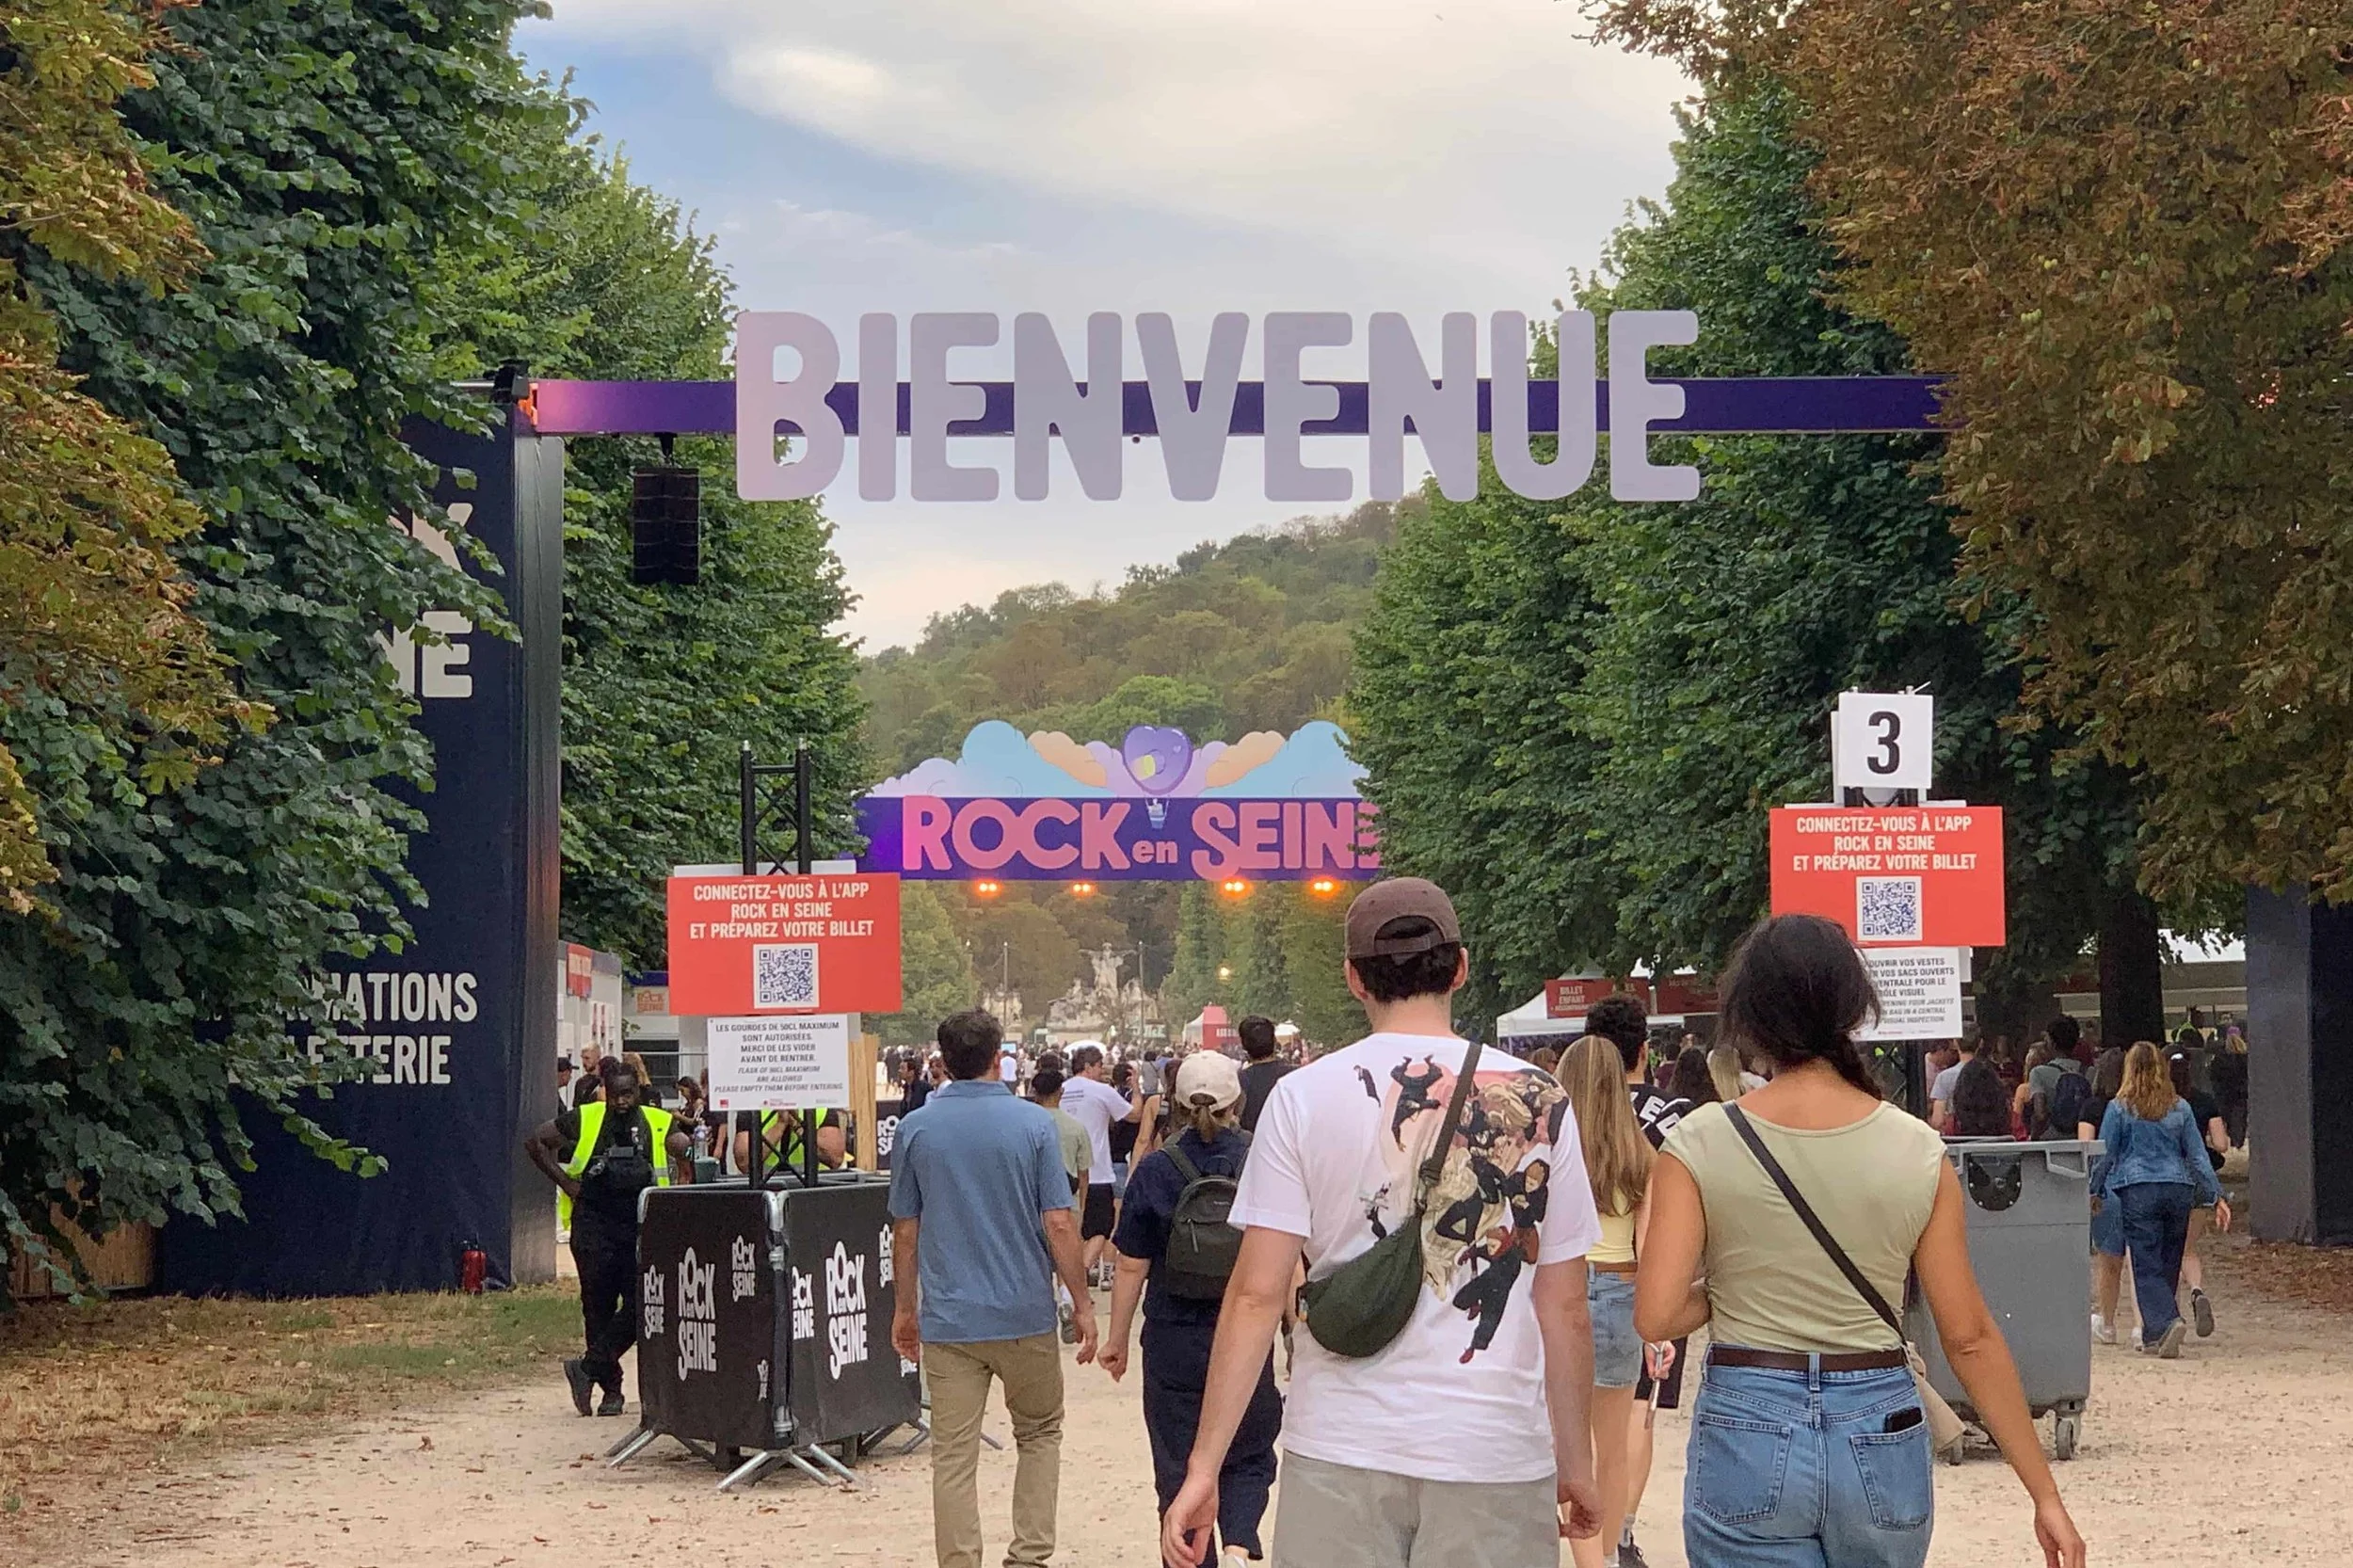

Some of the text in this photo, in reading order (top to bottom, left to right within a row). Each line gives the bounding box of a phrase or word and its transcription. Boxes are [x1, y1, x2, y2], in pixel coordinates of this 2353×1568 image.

[737, 312, 1700, 502] BIENVENUE
[1867, 711, 1901, 775] 3
[903, 795, 1381, 881] ROCK en SEINE
[1797, 811, 1973, 834] CONNECTEZ-VOUS À L'APP
[1834, 835, 1936, 852] ROCK EN SEINE
[1793, 852, 1977, 872] ET PRÉPAREZ VOTRE BILLET
[694, 879, 870, 901] CONNECTEZ-VOUS À L'APP
[731, 902, 833, 920] ROCK EN SEINE
[690, 919, 874, 938] ET PRÉPAREZ VOTRE BILLET
[1937, 977, 1946, 985] LE
[716, 1024, 729, 1032] LES
[730, 1023, 767, 1032] GOURDES
[799, 1021, 840, 1030] MAXIMUM
[766, 1044, 776, 1052] DE
[778, 1044, 792, 1052] LES
[793, 1043, 816, 1051] VIDER
[731, 1235, 756, 1271] ROCK
[679, 1246, 715, 1320] ROCK
[732, 1270, 756, 1302] SEINE
[792, 1266, 813, 1309] OCK
[826, 1240, 866, 1315] ROCK
[793, 1308, 814, 1340] EINE
[678, 1320, 717, 1381] SEINE
[828, 1313, 868, 1380] SEINE
